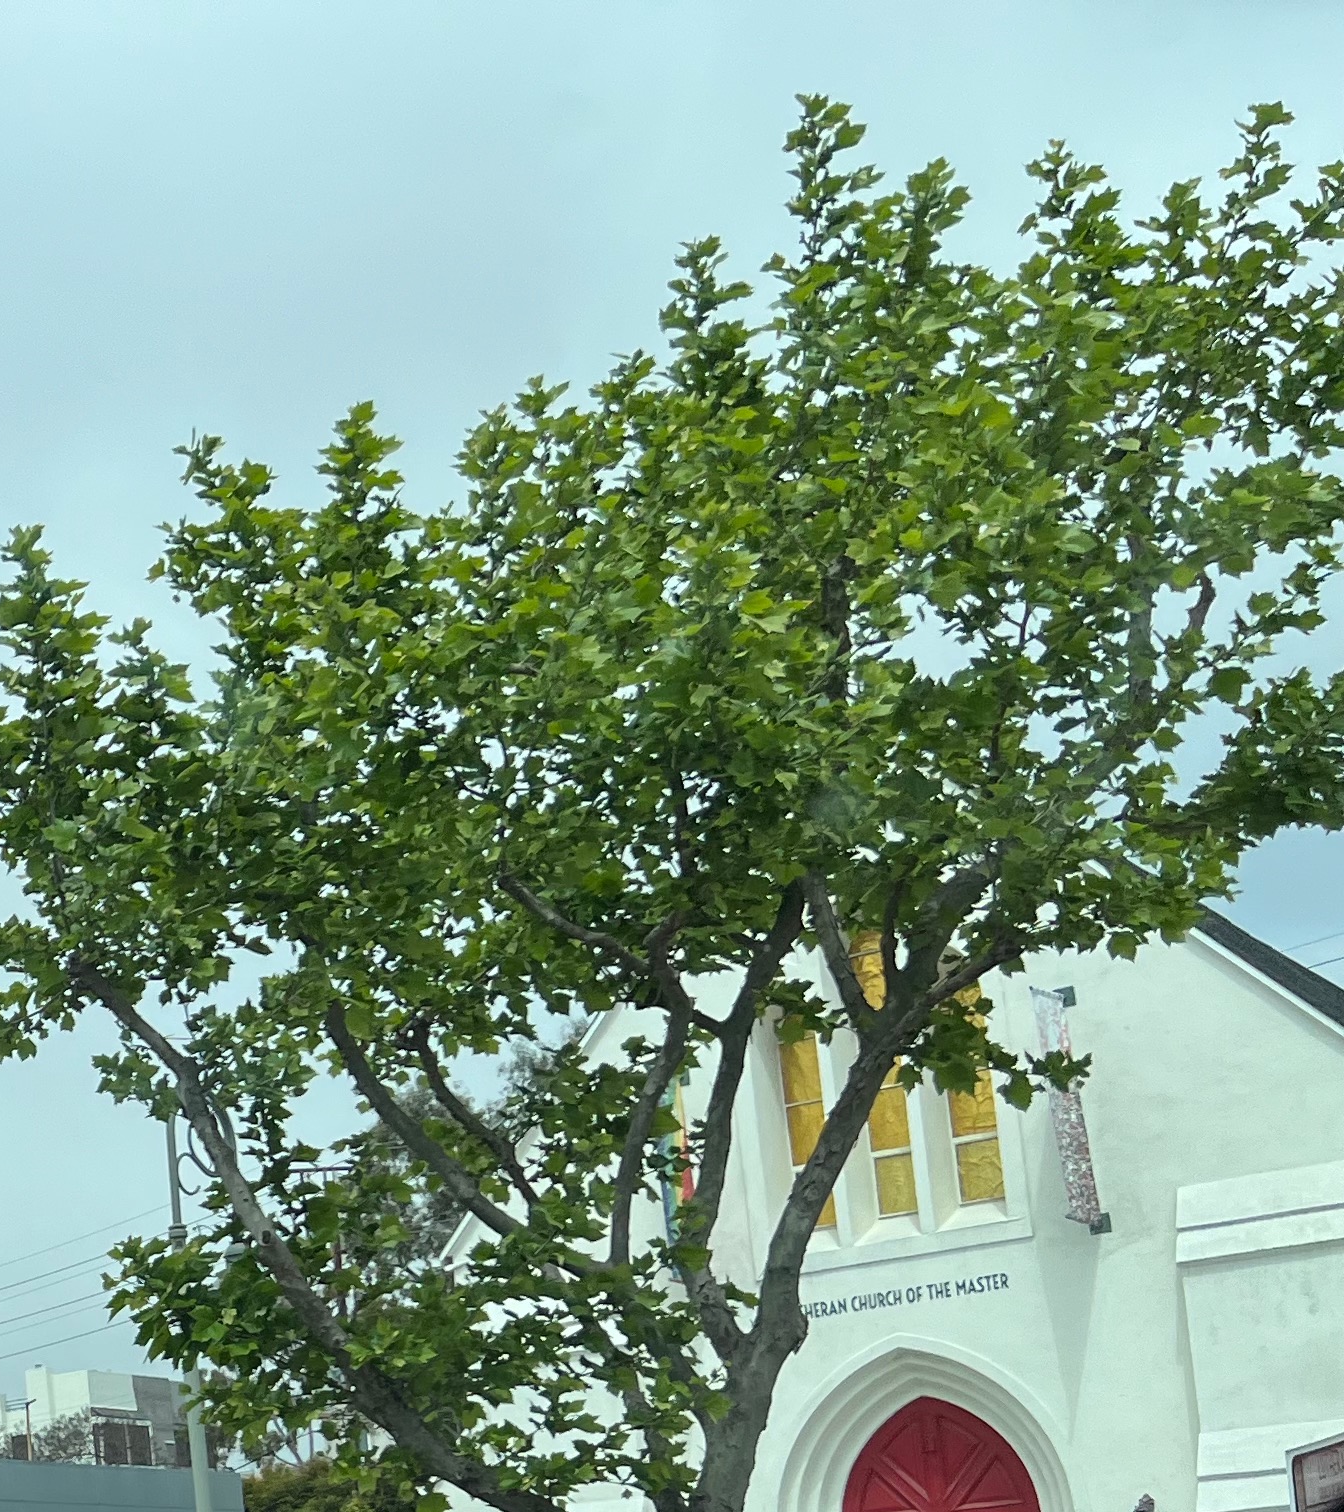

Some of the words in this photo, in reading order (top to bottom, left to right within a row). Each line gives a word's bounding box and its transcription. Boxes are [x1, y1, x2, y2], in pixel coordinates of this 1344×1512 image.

[799, 1298, 848, 1319] HERAN
[851, 1289, 902, 1312] CHURCH
[906, 1286, 923, 1304] OF
[926, 1281, 951, 1301] THE
[955, 1272, 1009, 1297] MASTER
